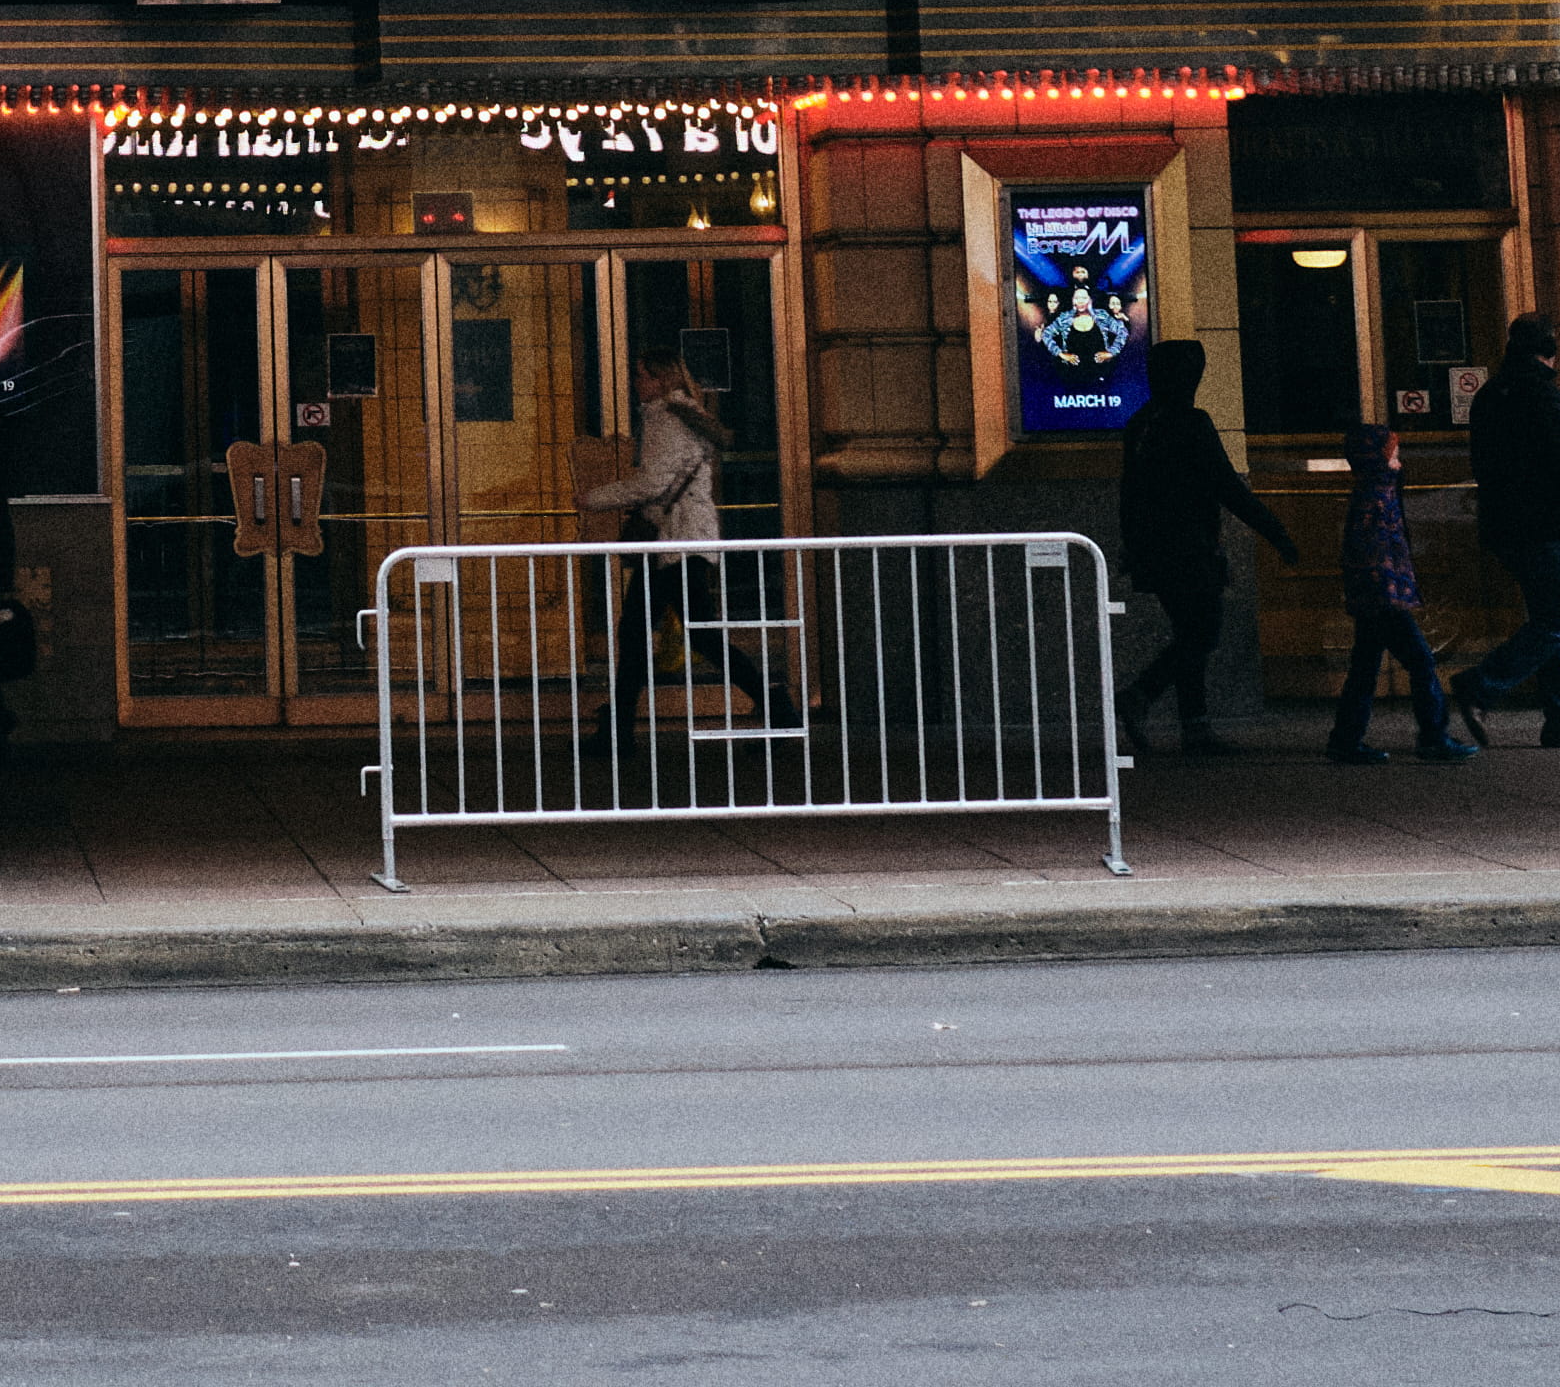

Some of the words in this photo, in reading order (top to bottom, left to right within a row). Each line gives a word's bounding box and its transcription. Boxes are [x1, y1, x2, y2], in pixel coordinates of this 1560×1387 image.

[1017, 208, 1041, 219] THE
[1103, 206, 1138, 217] DISCO
[2, 380, 15, 391] 19
[1054, 395, 1106, 408] MARCH
[1108, 395, 1121, 407] 19
